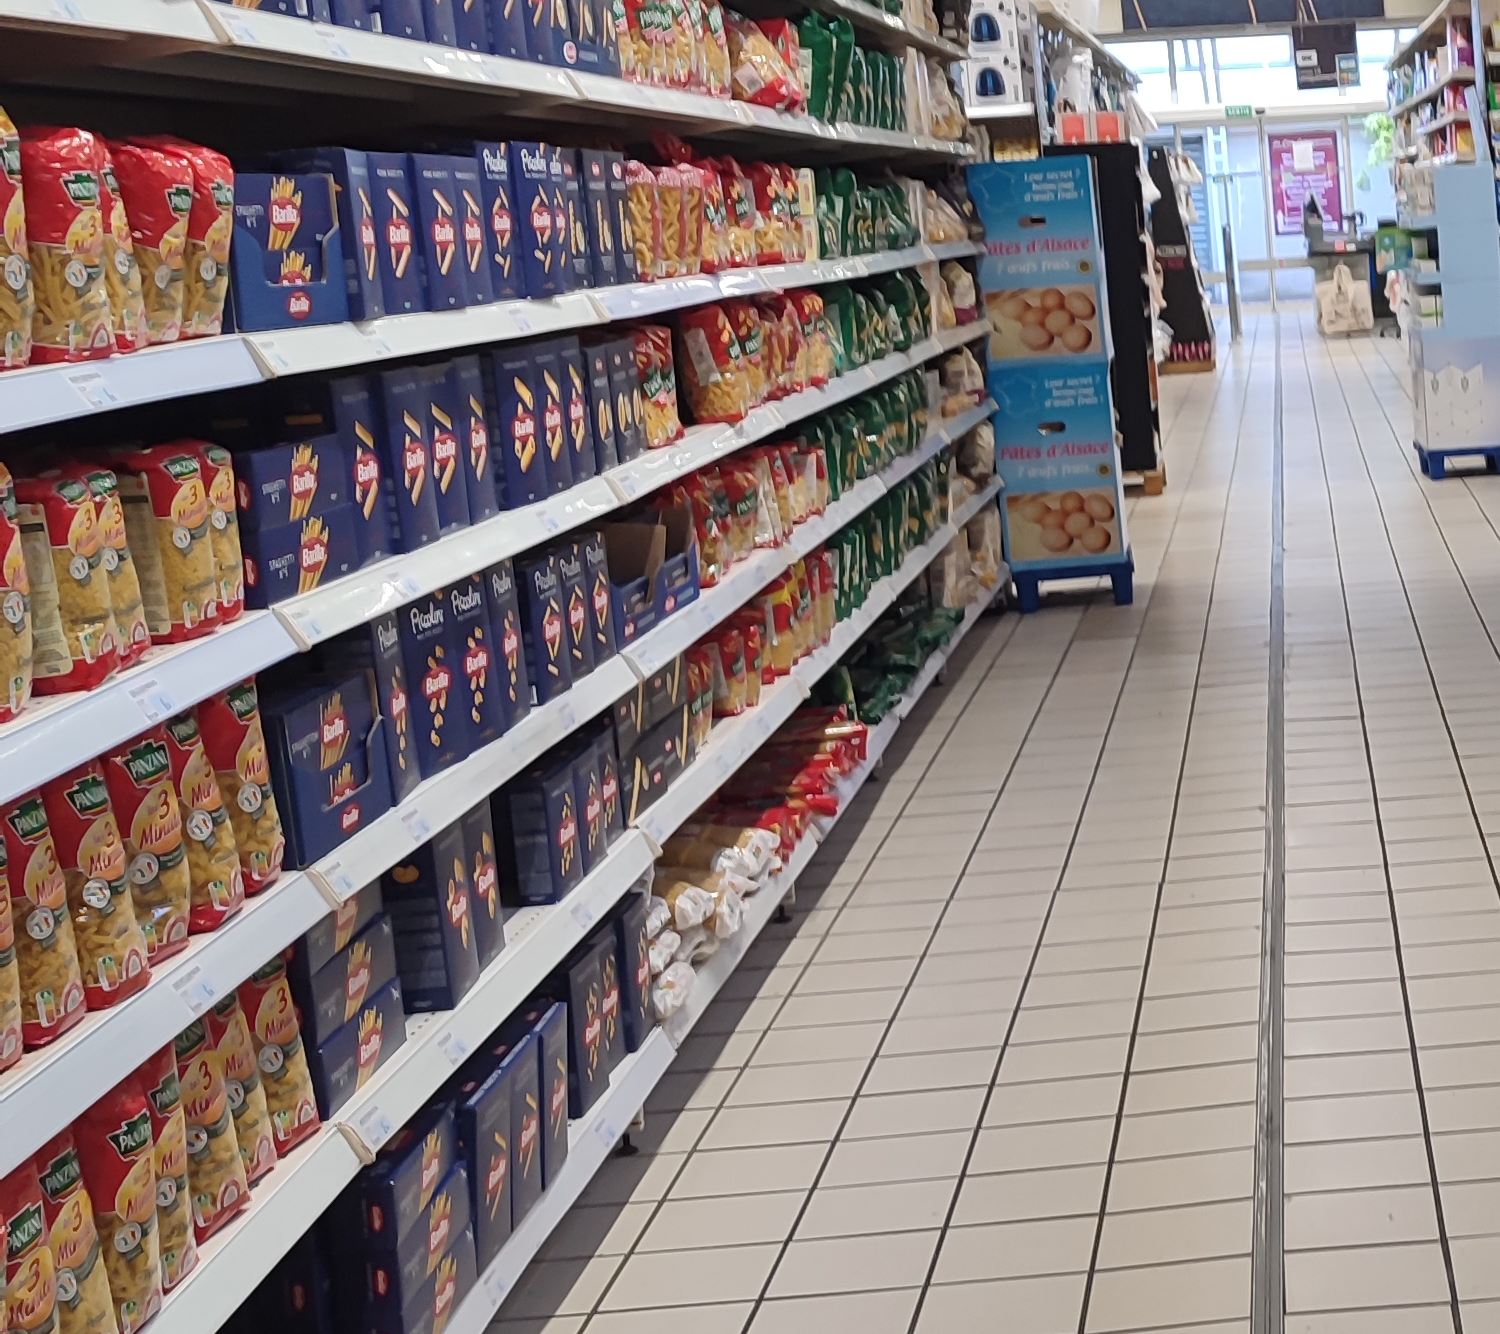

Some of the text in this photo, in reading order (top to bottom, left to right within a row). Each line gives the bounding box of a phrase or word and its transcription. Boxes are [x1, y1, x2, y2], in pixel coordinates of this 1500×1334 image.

[272, 204, 299, 223] Barilla
[987, 241, 1021, 256] âtes
[1001, 441, 1111, 460] Pâtes d'Alsace
[303, 543, 325, 566] Barilla
[451, 585, 482, 616] Piccolini
[410, 601, 444, 634] Piccolini
[426, 672, 450, 695] Barilla
[158, 790, 171, 820] 3
[277, 987, 288, 1014] 3
[200, 1061, 212, 1090] 3
[72, 1200, 83, 1233] 3
[27, 1258, 41, 1293] 3
